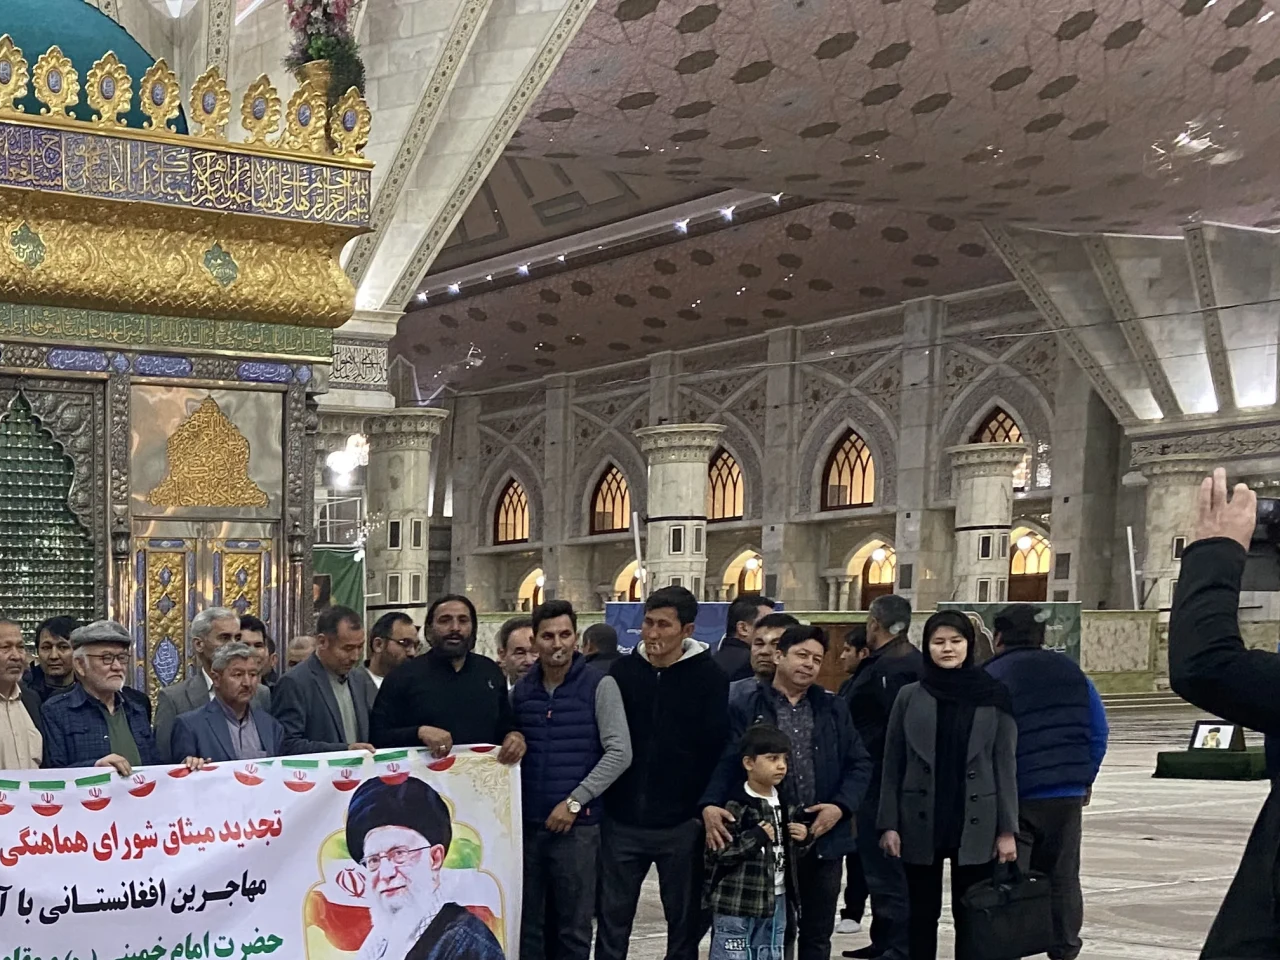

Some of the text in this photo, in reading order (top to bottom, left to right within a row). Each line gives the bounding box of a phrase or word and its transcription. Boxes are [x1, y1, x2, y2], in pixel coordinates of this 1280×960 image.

[0, 824, 89, 867] هماهنگی
[93, 820, 158, 861] شورای
[163, 816, 215, 856] میثاق
[219, 809, 283, 848] تجدید
[17, 888, 34, 924] با
[39, 877, 166, 925] افغانستانی
[170, 869, 267, 914] مهاجرین
